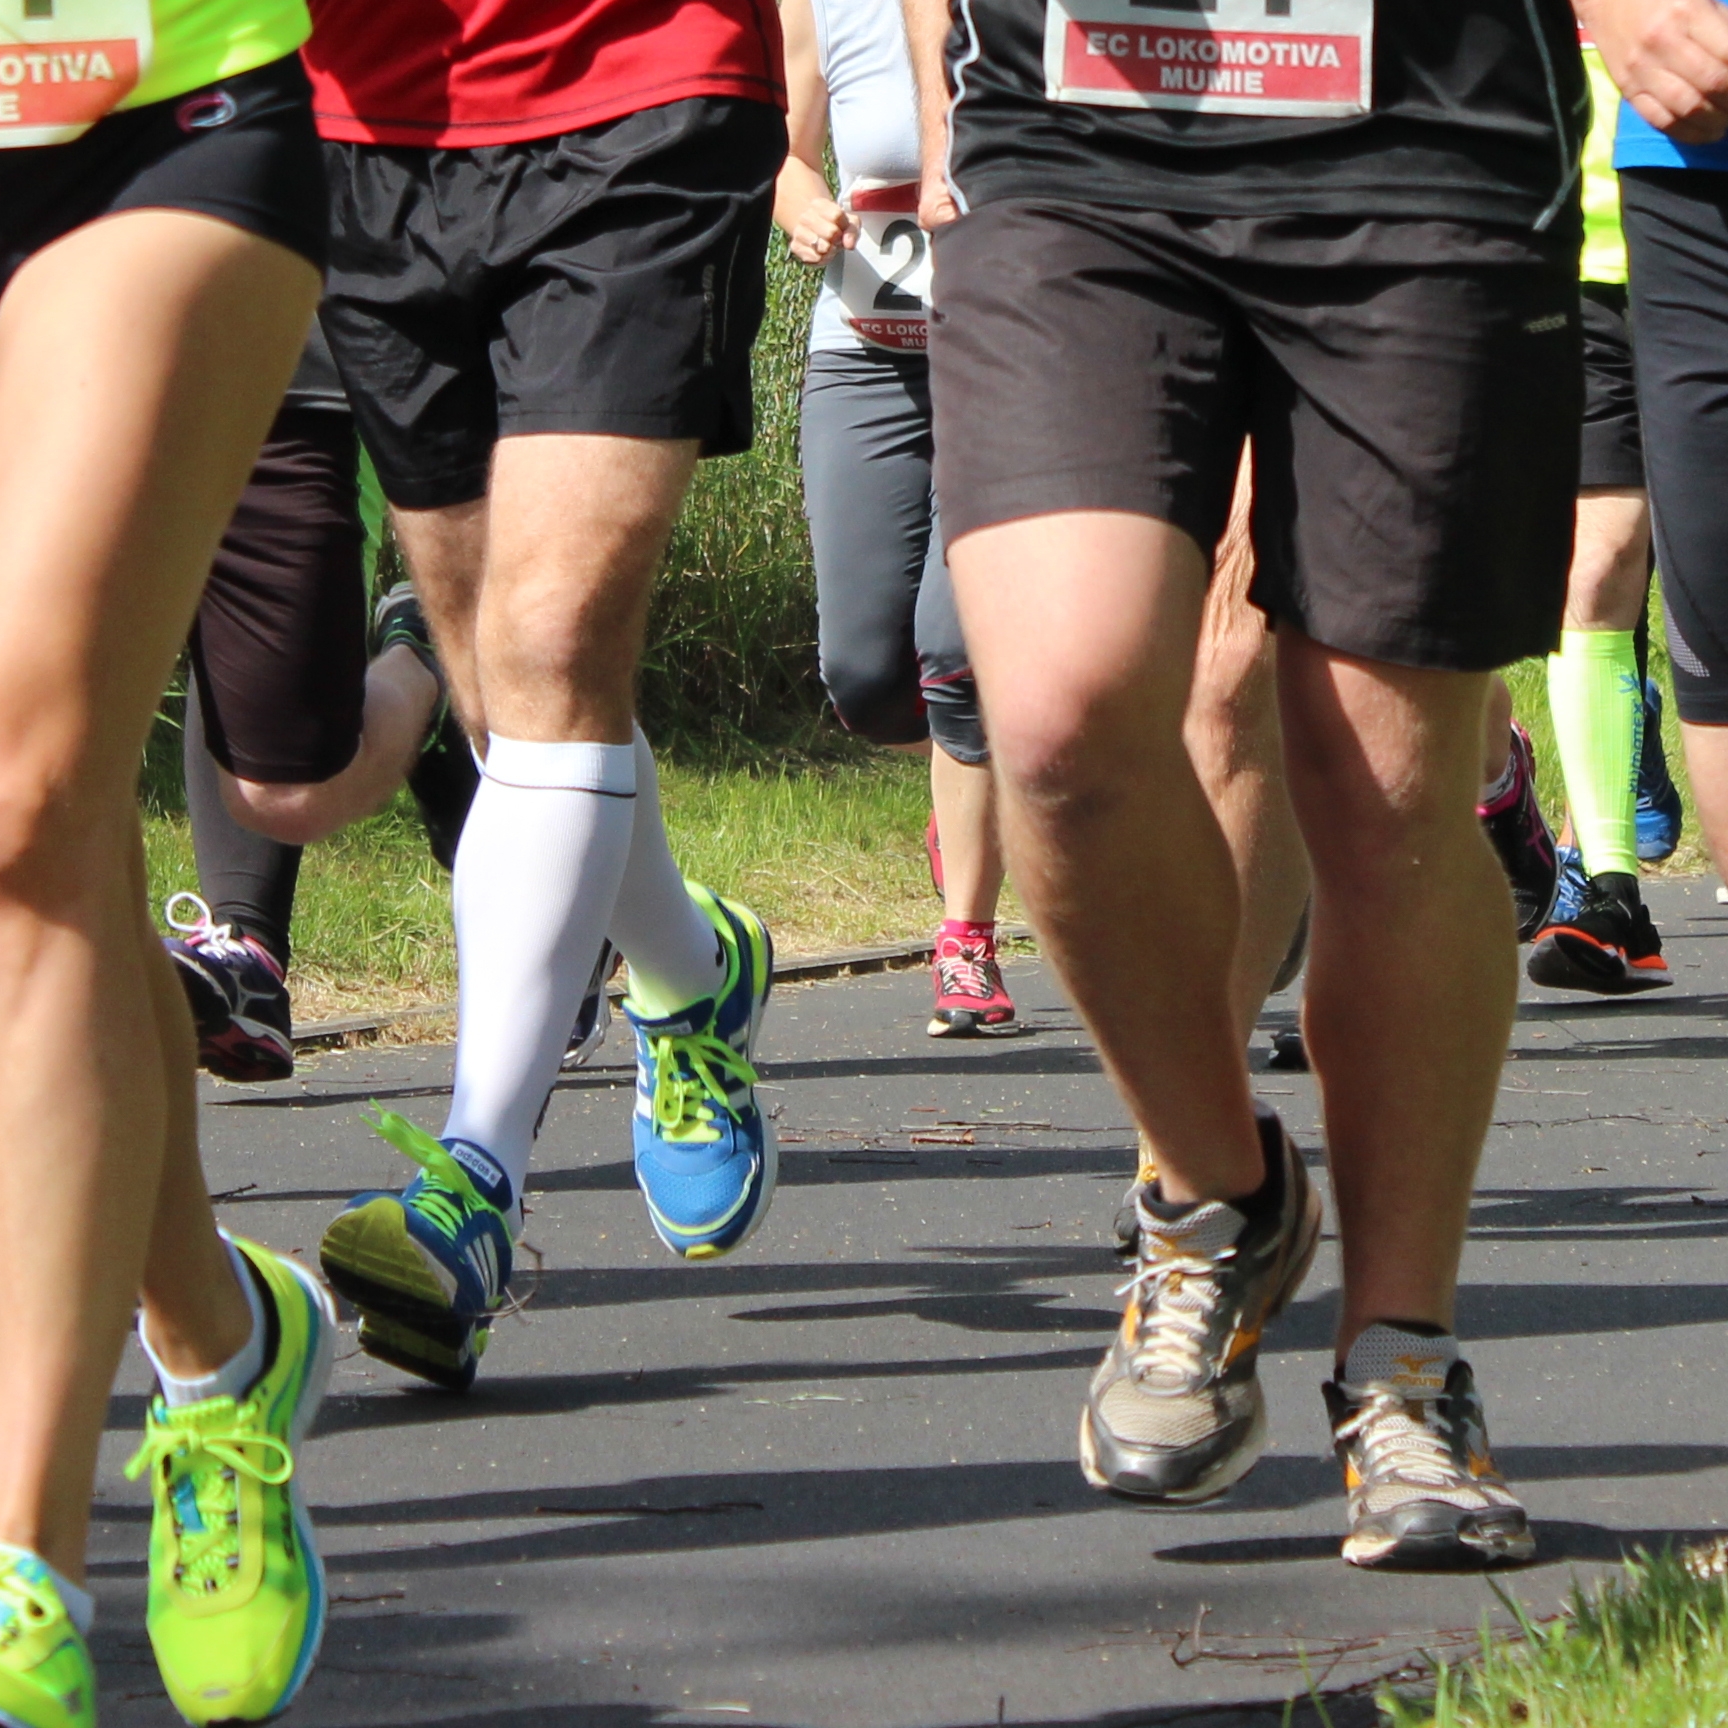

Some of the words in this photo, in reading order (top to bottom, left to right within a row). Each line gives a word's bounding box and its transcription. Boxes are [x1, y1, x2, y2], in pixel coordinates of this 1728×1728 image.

[1086, 30, 1129, 59] EC
[1137, 35, 1342, 69] LOKOMOTIVA
[1160, 65, 1265, 95] MUMIE
